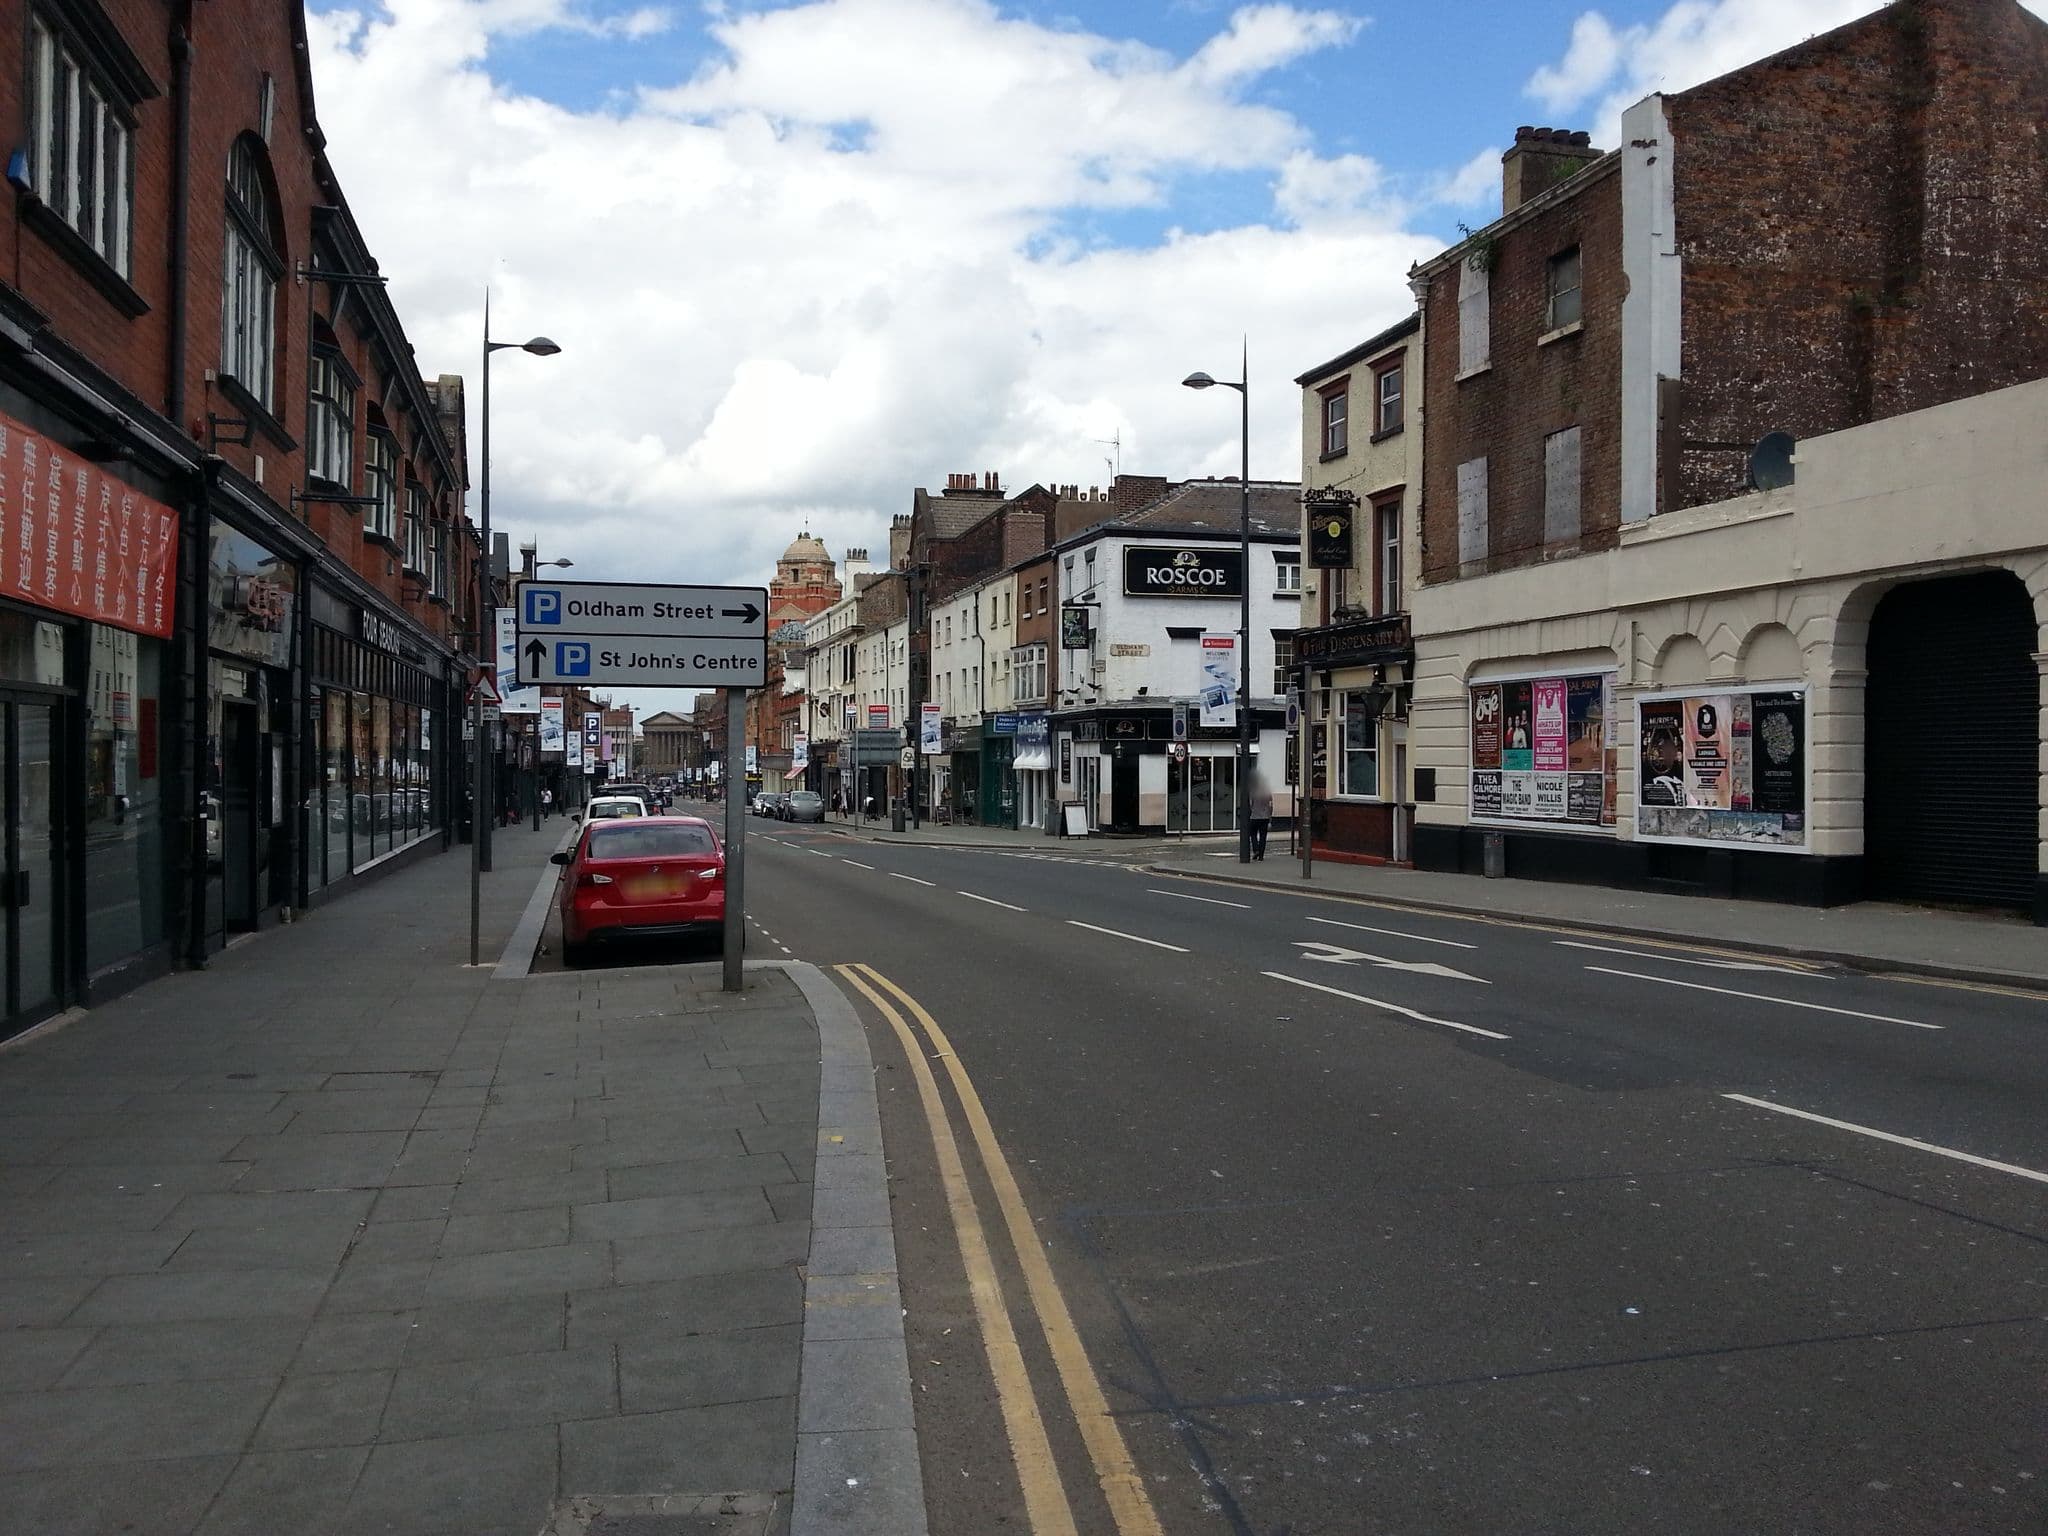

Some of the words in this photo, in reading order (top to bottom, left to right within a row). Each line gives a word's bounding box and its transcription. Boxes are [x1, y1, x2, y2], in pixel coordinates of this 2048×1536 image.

[1146, 567, 1227, 586] ROSCOE
[1175, 586, 1200, 594] ARMS
[567, 600, 644, 618] Oldham
[653, 602, 714, 620] Street
[1330, 631, 1393, 653] DISPENSARY
[599, 651, 621, 667] St
[628, 652, 685, 669] John's
[692, 654, 758, 669] Centre
[588, 718, 597, 729] P
[1176, 748, 1184, 757] 20
[1478, 774, 1497, 785] THEA
[1473, 785, 1502, 794] GILMORE
[1512, 780, 1522, 792] THE
[1536, 782, 1563, 791] NICOLE
[1518, 793, 1532, 806] BAND
[1537, 794, 1562, 803] WILLIS
